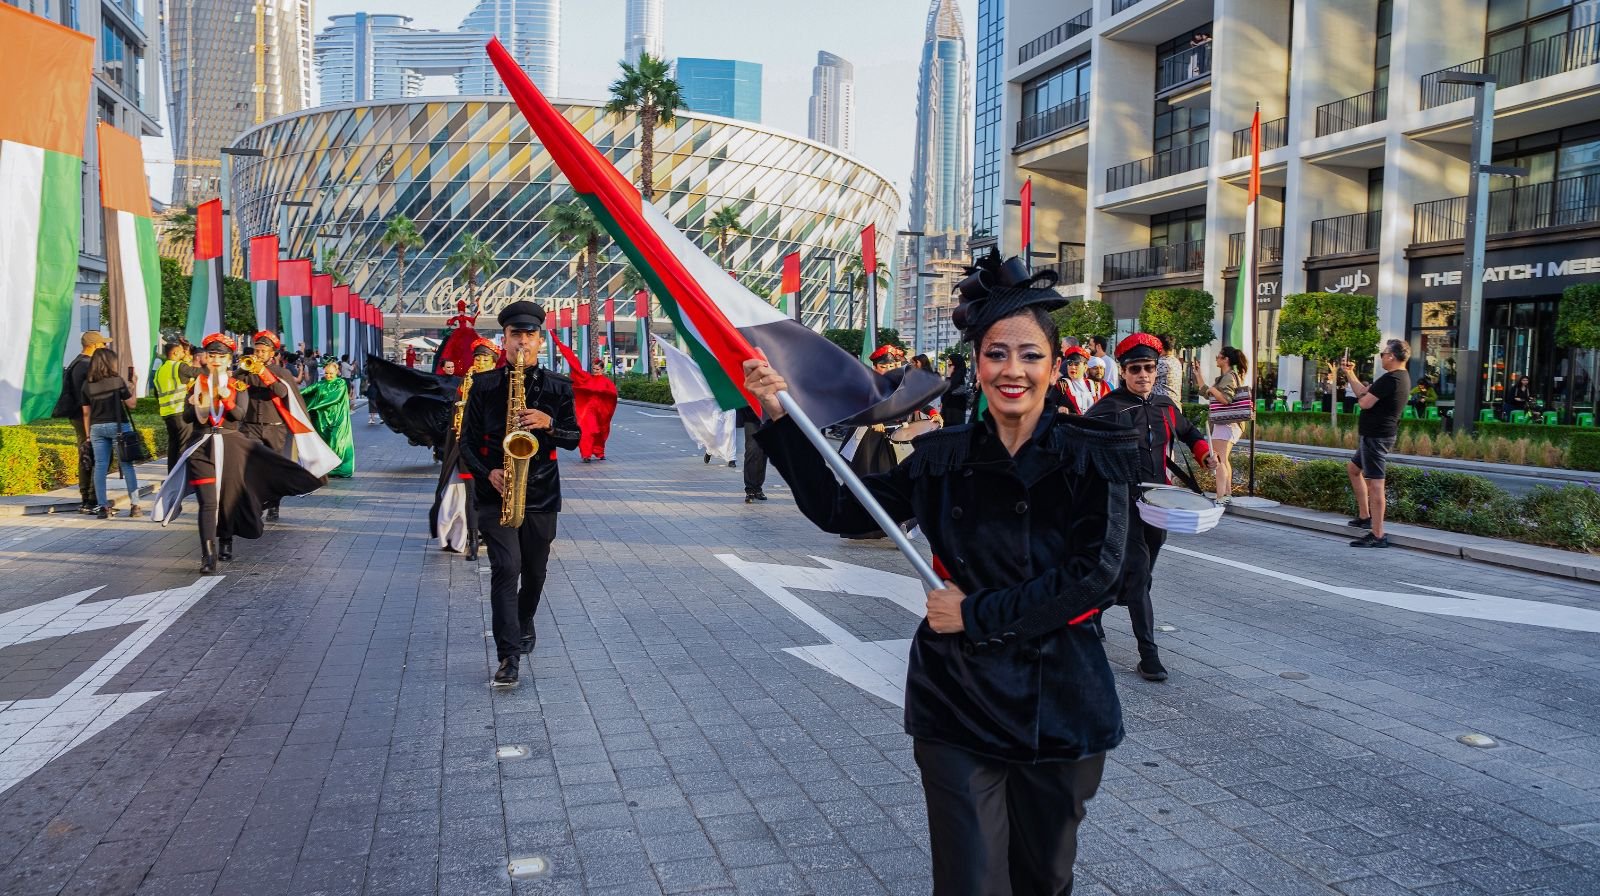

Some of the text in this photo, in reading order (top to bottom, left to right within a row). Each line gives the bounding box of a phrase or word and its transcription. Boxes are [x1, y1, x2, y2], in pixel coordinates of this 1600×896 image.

[1421, 270, 1463, 287] THE
[1482, 263, 1543, 283] ATCH
[1256, 281, 1279, 296] CEY
